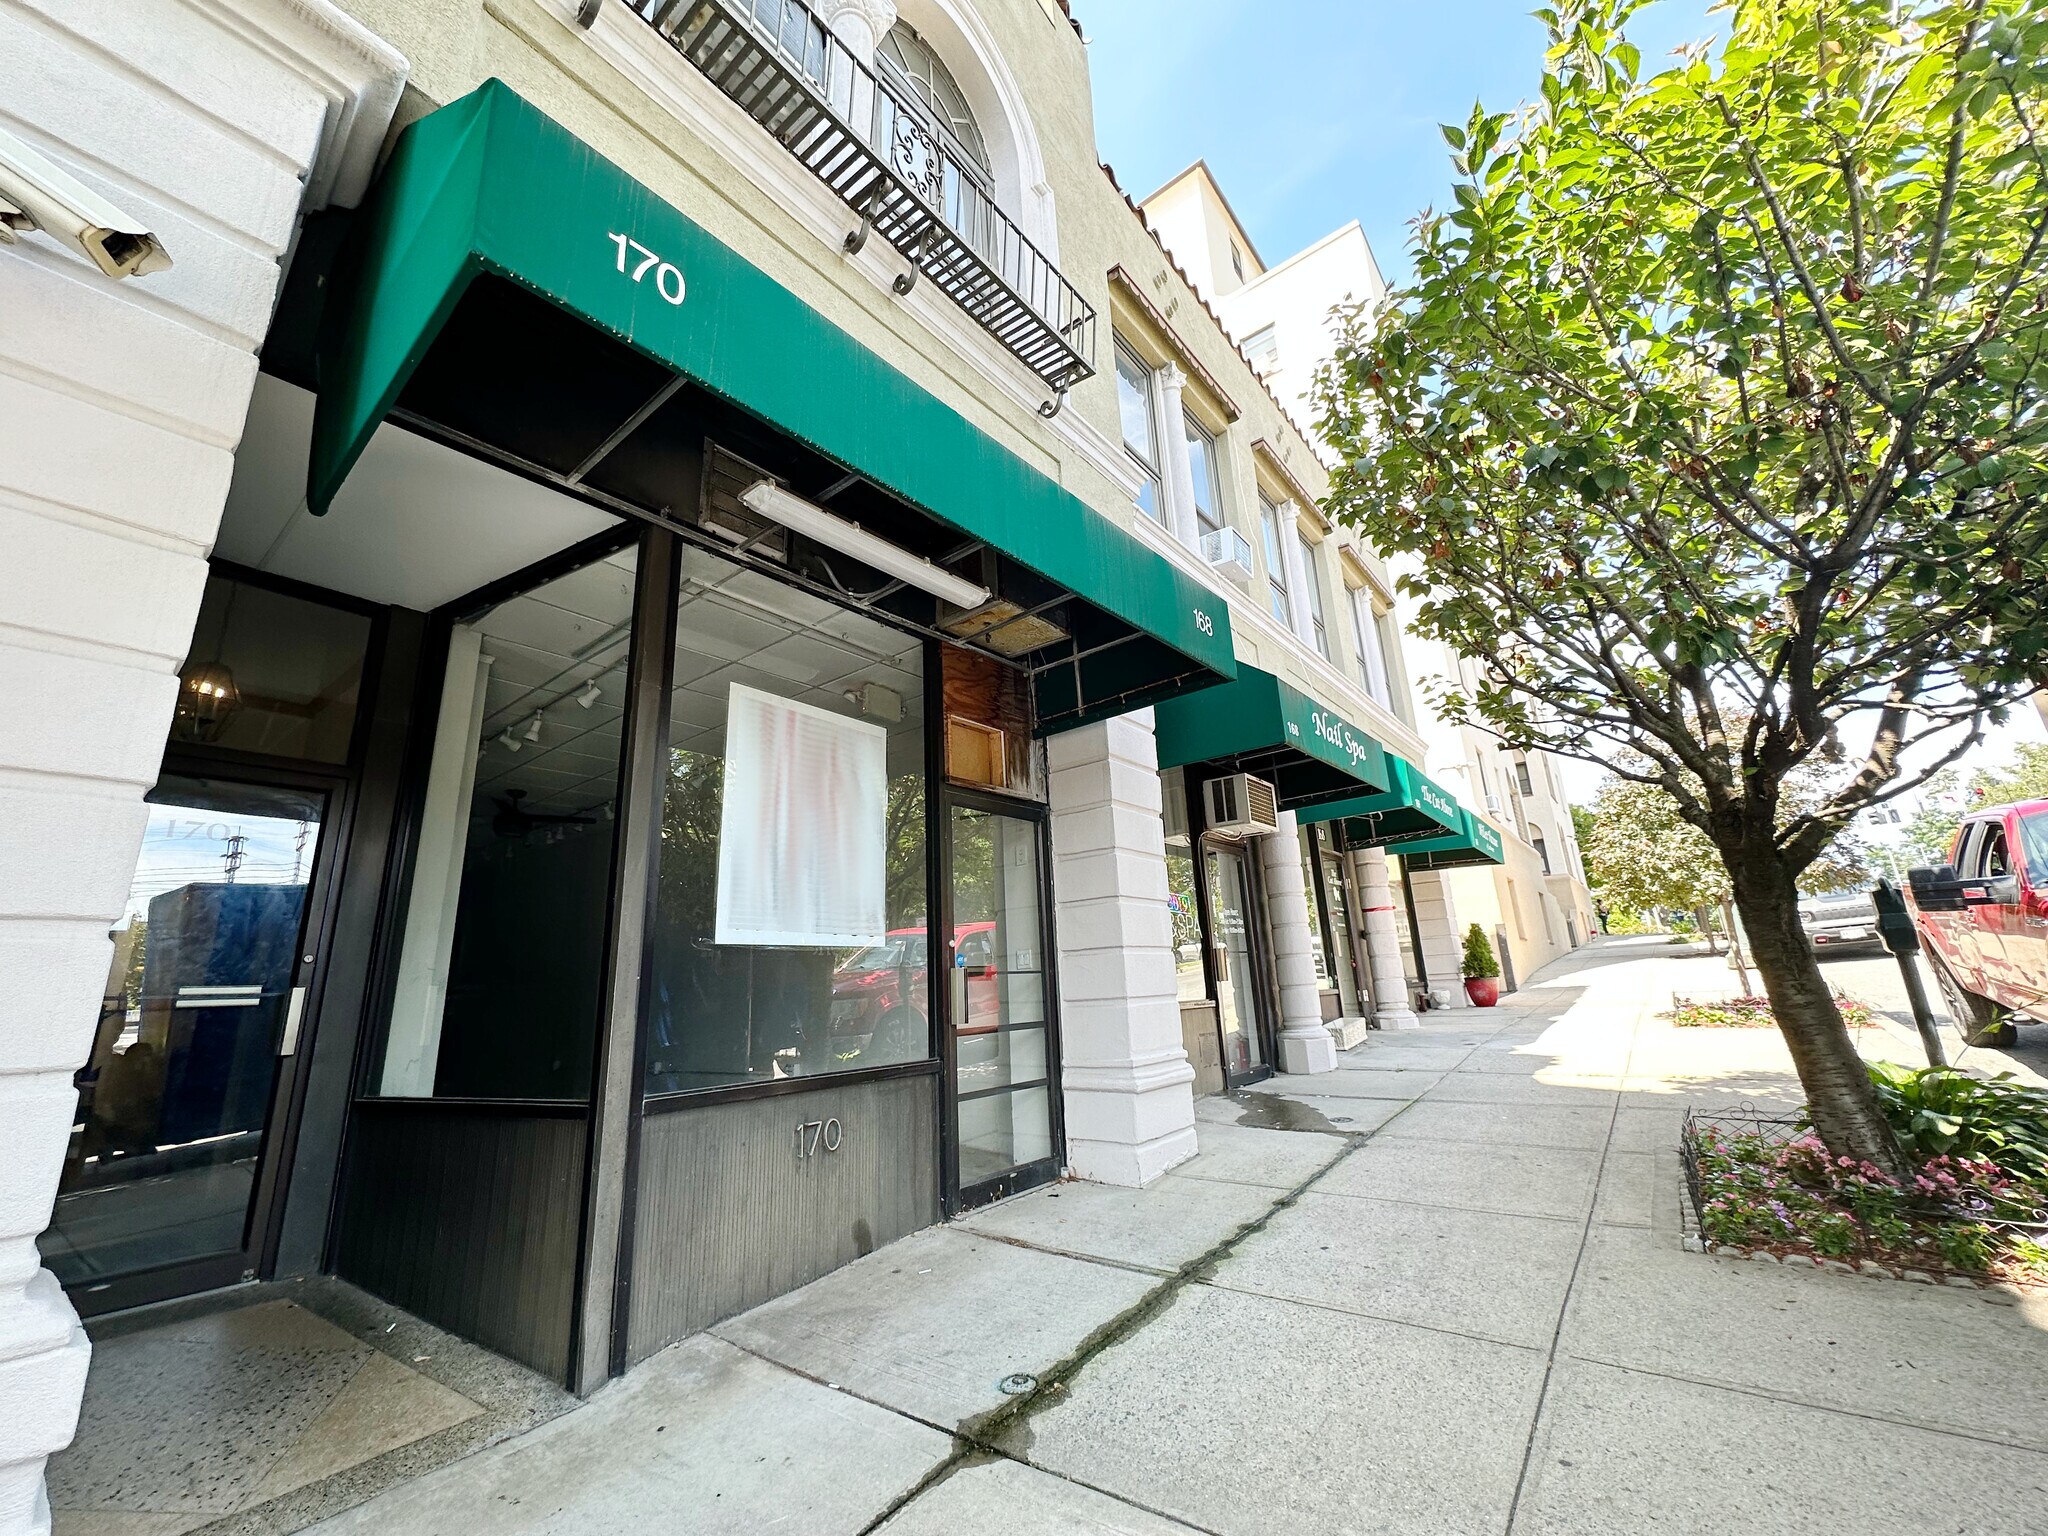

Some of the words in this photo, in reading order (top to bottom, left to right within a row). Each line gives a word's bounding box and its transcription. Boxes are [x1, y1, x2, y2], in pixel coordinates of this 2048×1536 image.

[607, 231, 686, 306] 170
[1192, 608, 1213, 637] 168
[1286, 721, 1300, 737] 168
[1311, 712, 1343, 749] Nail
[1344, 731, 1367, 766] Spa
[166, 819, 232, 842] 170
[796, 1118, 842, 1158] 170
